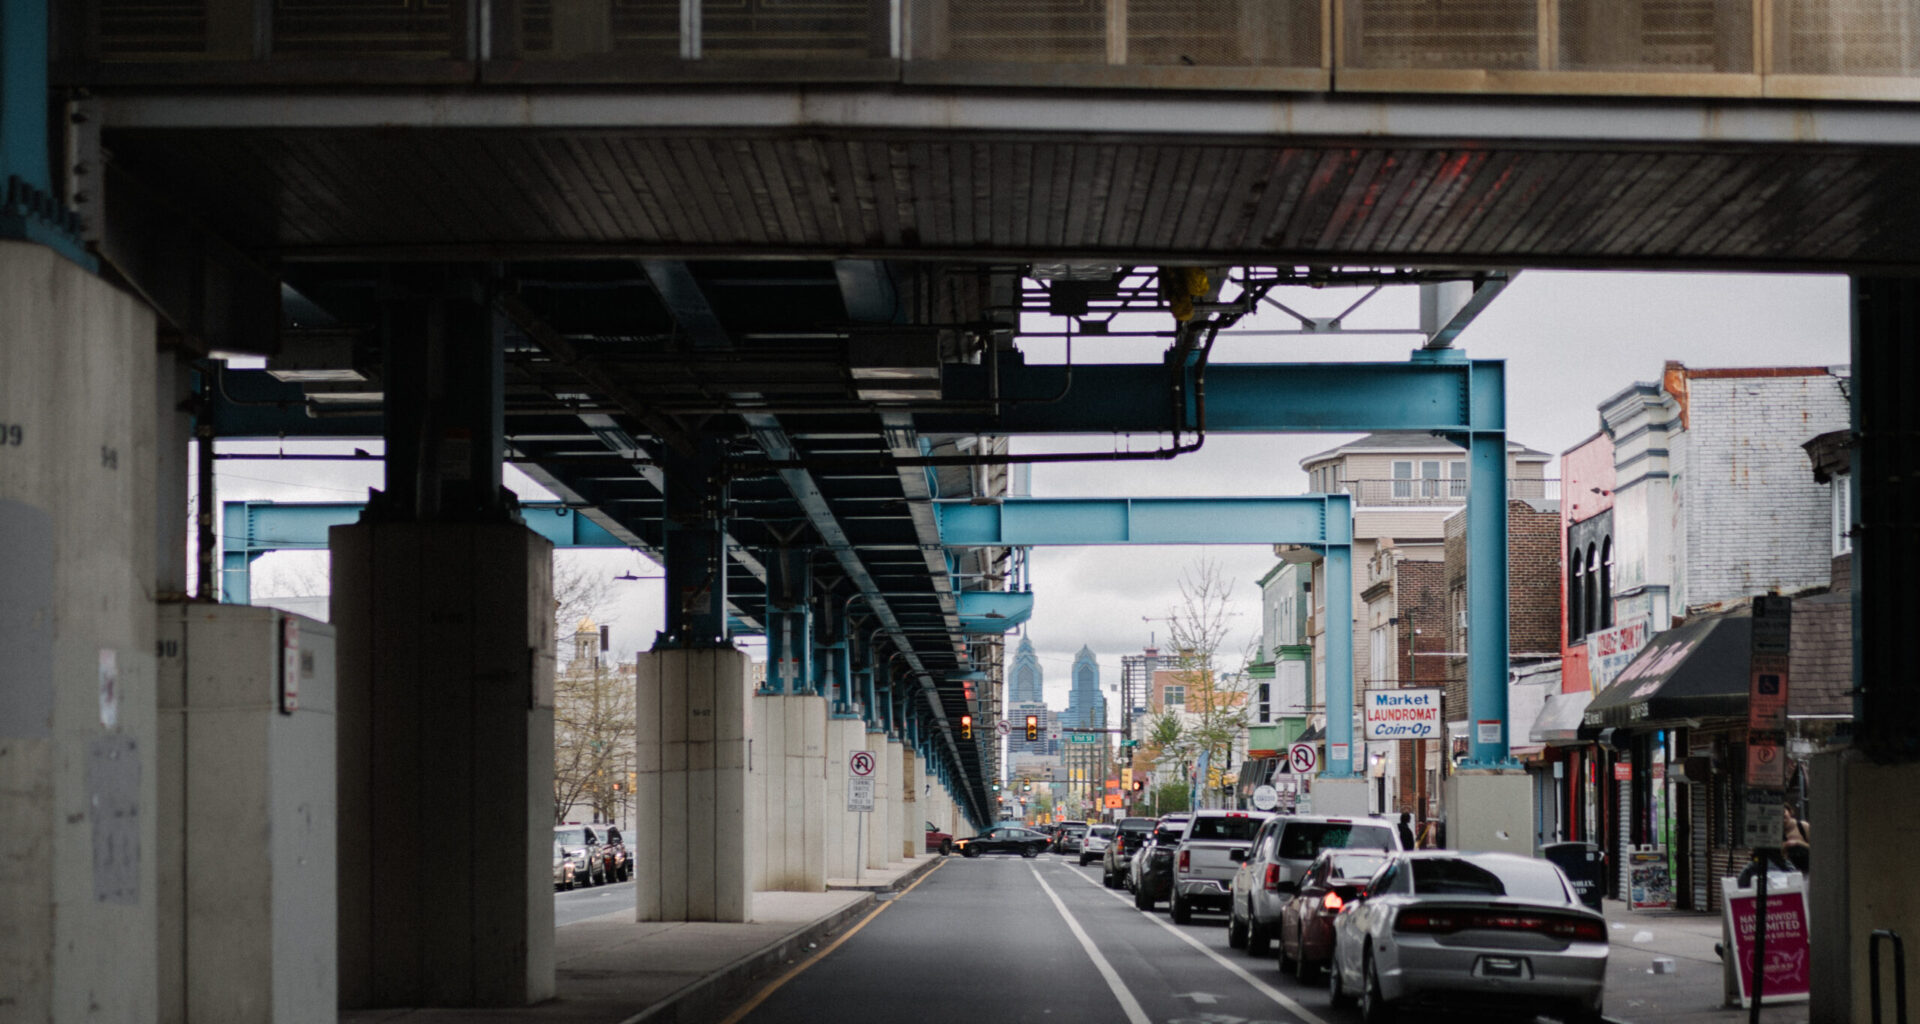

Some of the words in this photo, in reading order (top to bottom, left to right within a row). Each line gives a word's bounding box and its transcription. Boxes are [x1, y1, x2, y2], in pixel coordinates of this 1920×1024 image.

[1376, 694, 1429, 705] Market
[1368, 708, 1437, 721] LAUNDROMAT
[1375, 723, 1431, 736] Coin-Op
